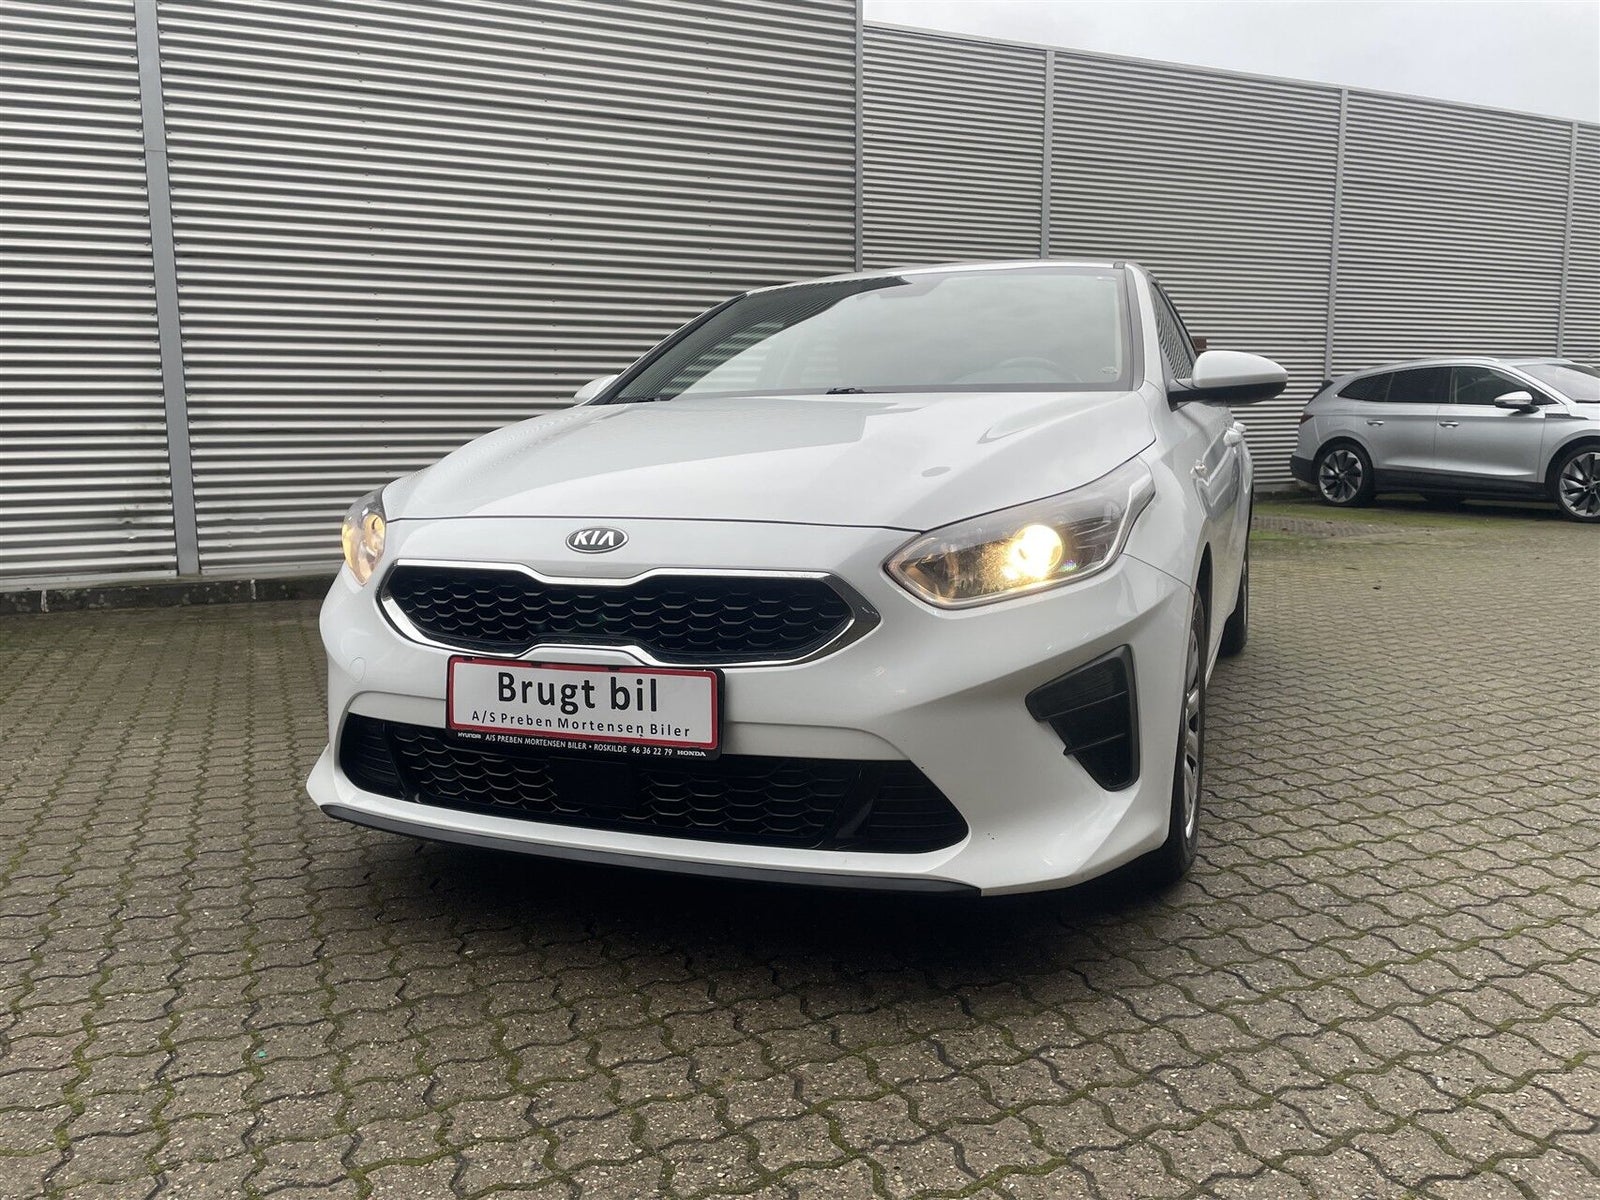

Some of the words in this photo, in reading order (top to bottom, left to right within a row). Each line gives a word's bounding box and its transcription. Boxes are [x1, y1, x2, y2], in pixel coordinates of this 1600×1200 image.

[574, 530, 614, 546] KIA
[498, 671, 596, 715] Brugt
[610, 676, 657, 712] bil
[472, 710, 496, 724] A/S
[501, 712, 552, 728] Preben
[558, 718, 644, 734] Mortensen
[650, 723, 690, 737] Biler
[485, 734, 496, 742] A/S
[497, 734, 523, 744] PREBEN
[524, 738, 566, 748] MORTENSEN
[568, 741, 587, 750] BILER
[594, 743, 628, 753] ROSKILDE
[664, 748, 673, 756] 79
[677, 750, 707, 758] HONDA
